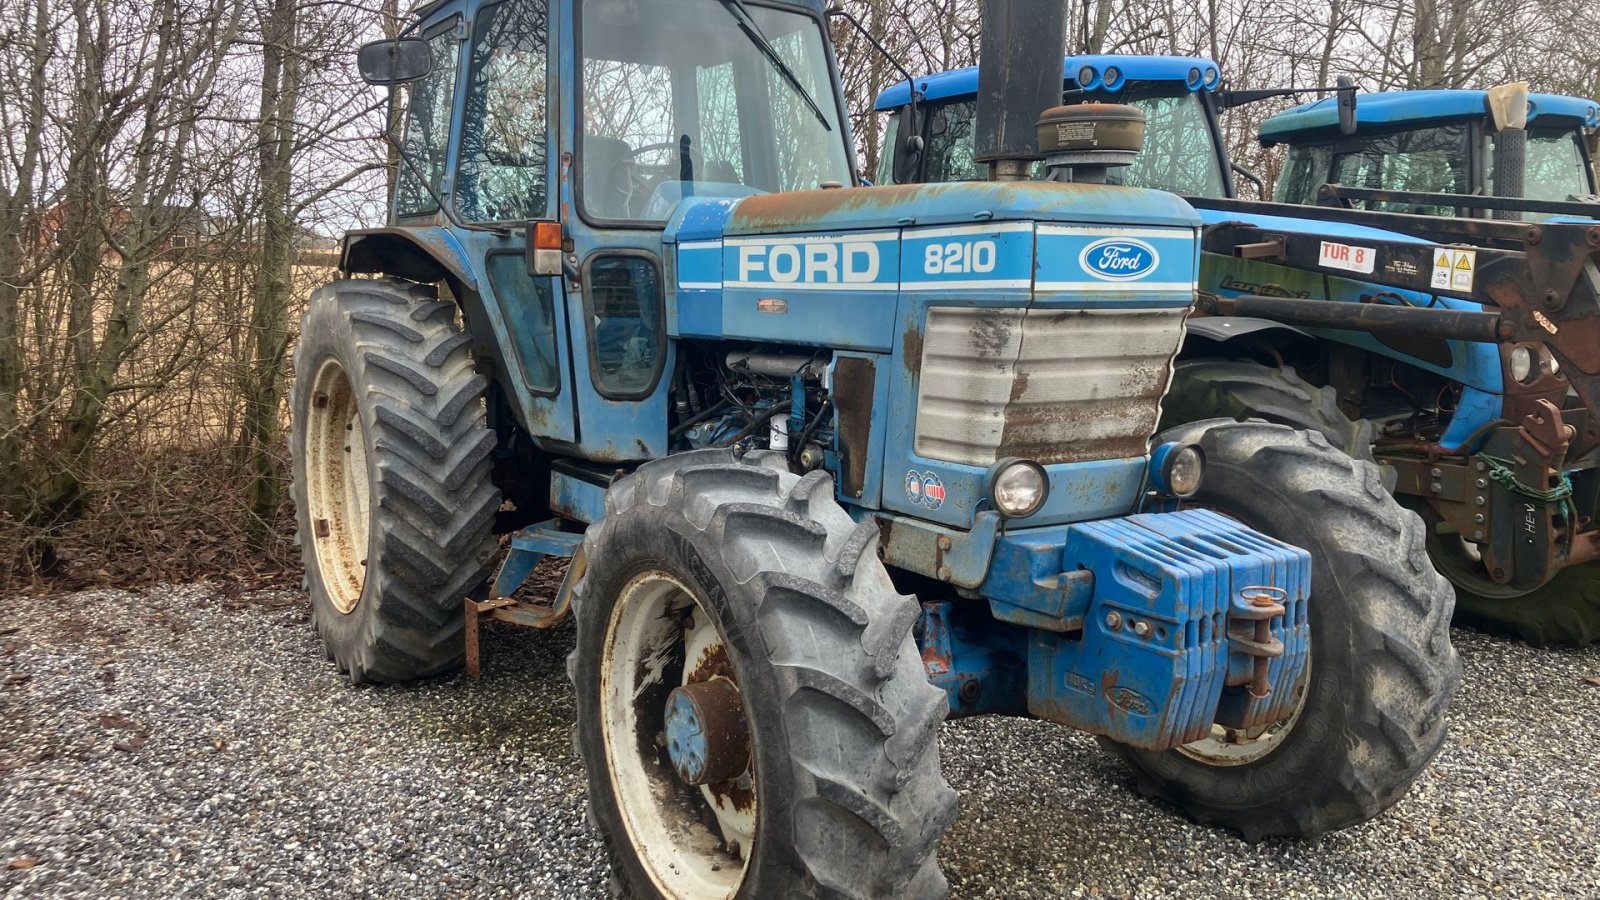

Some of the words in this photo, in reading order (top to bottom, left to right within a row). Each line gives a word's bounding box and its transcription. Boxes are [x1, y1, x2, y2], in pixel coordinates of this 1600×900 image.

[739, 241, 880, 283] FORD
[924, 240, 996, 275] 8210
[1098, 246, 1142, 270] Ford
[1322, 242, 1350, 261] TUR
[1355, 248, 1365, 264] 8
[1115, 686, 1151, 716] Ford
